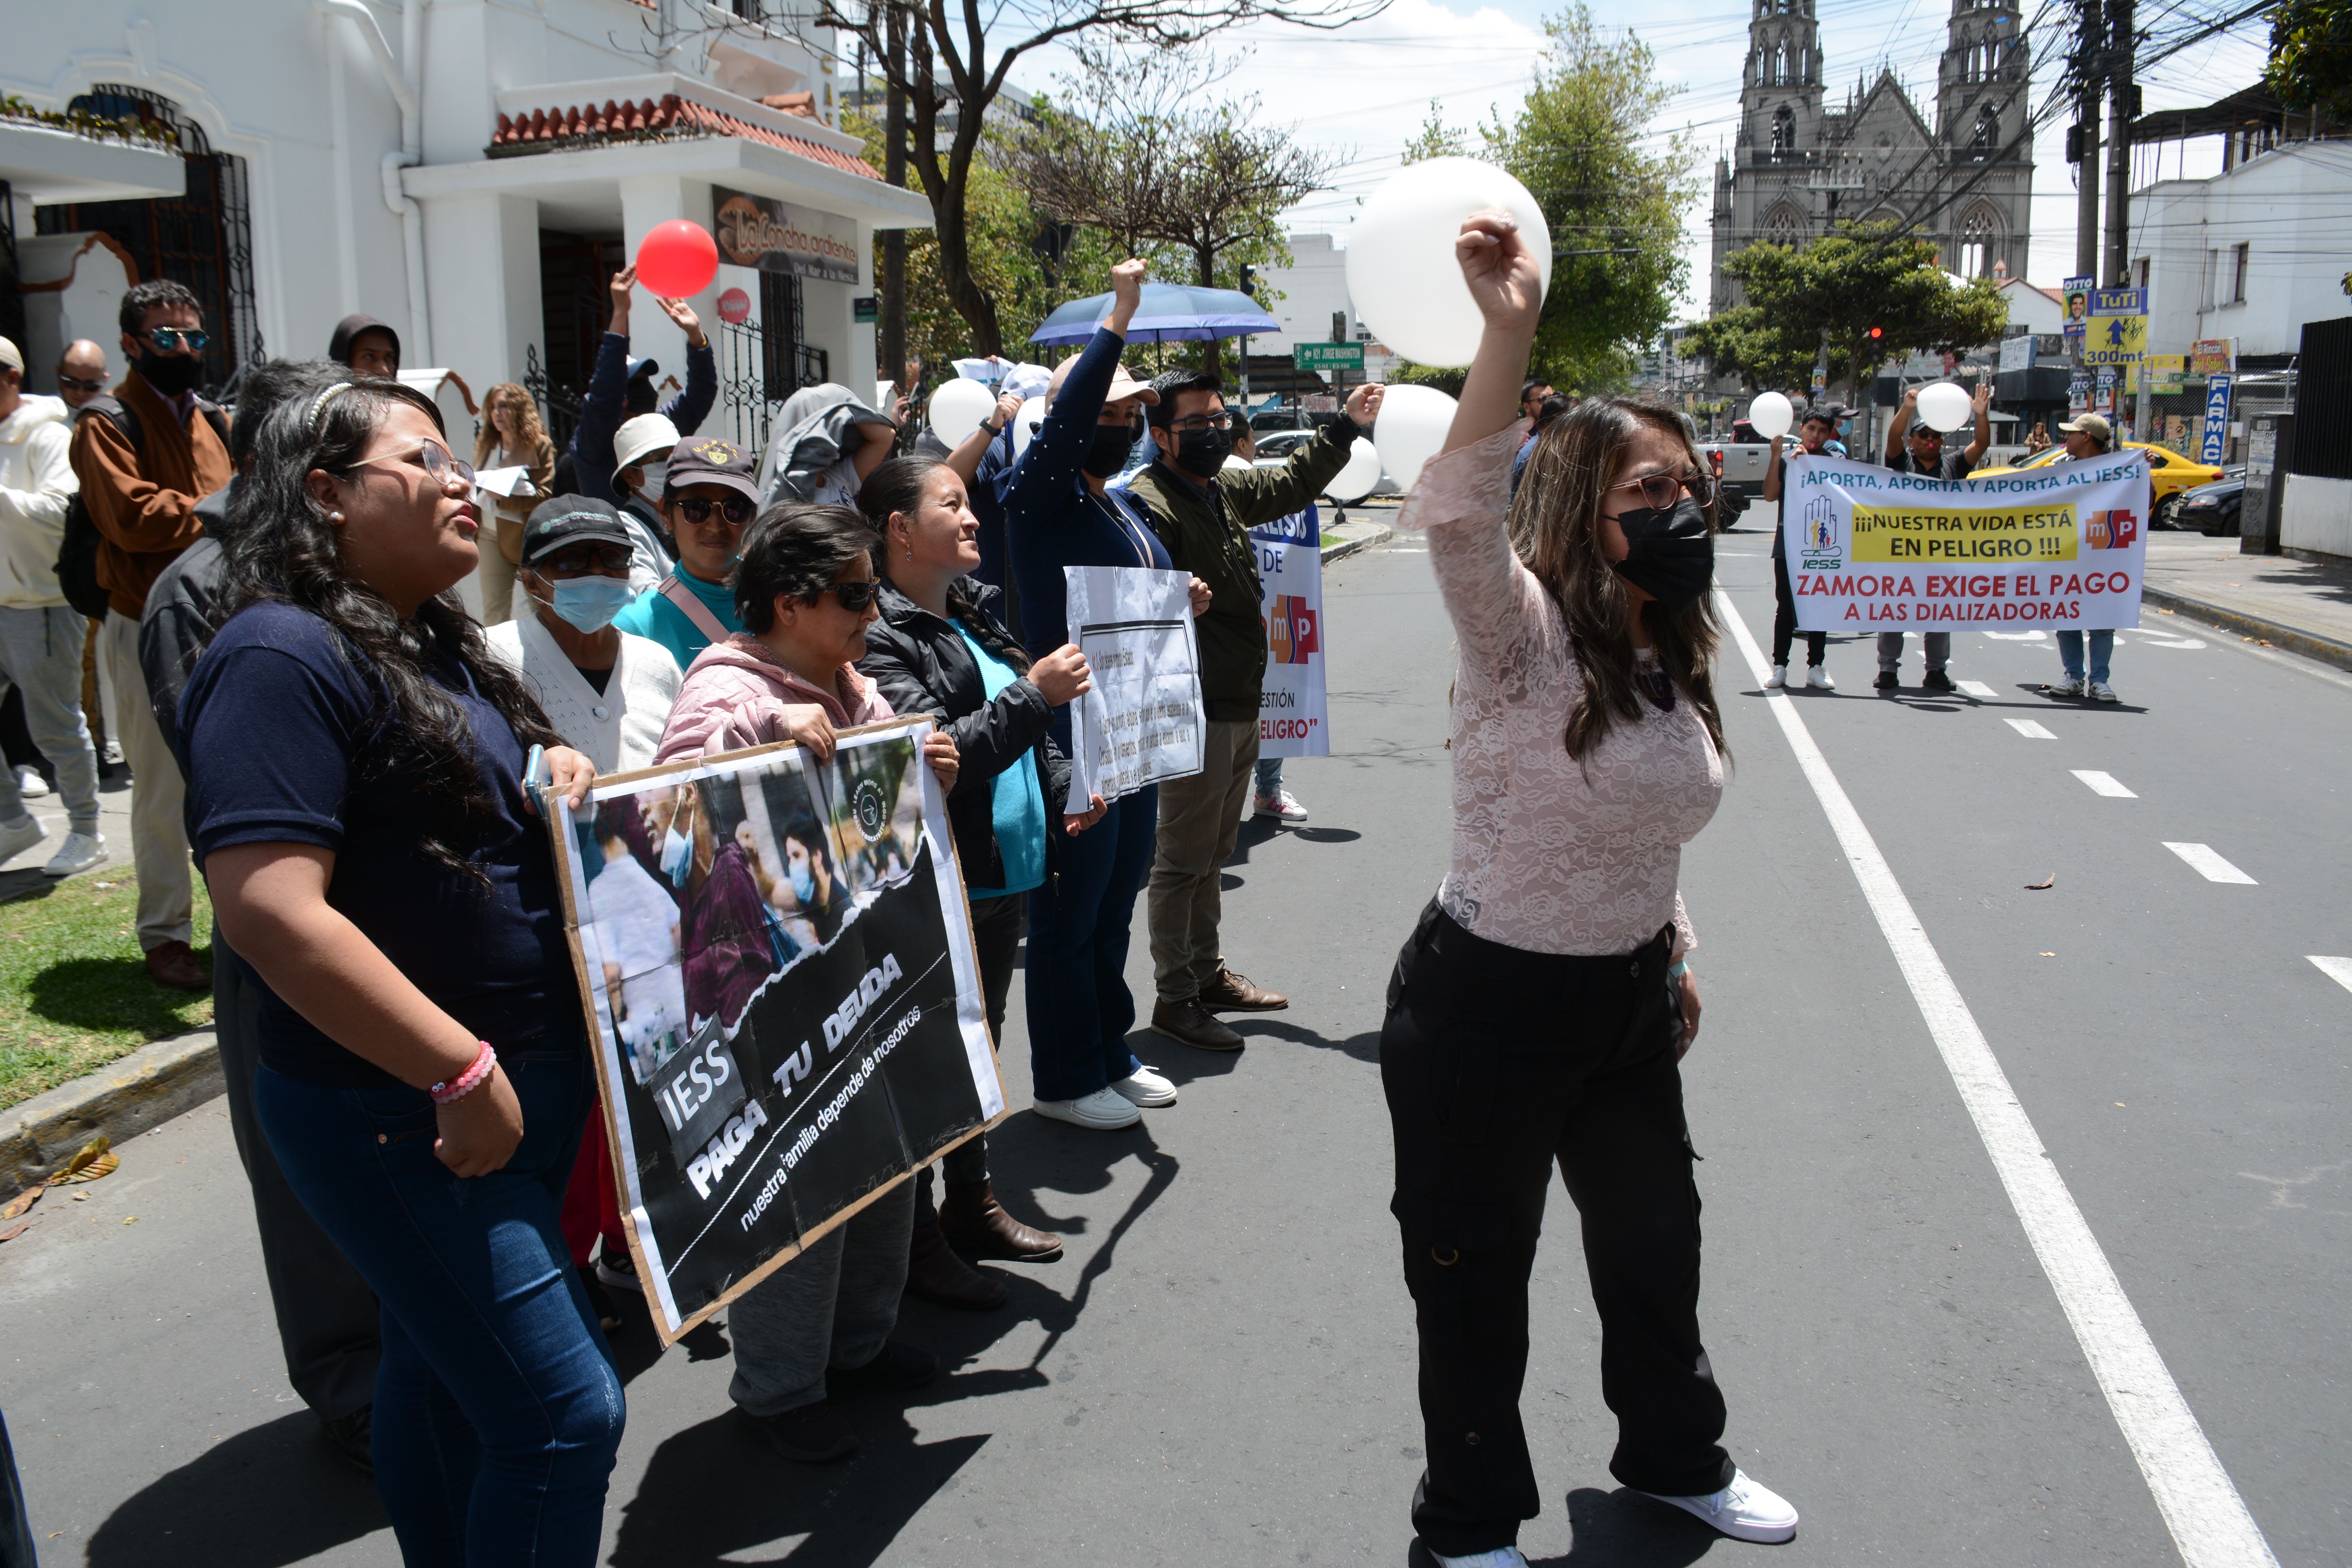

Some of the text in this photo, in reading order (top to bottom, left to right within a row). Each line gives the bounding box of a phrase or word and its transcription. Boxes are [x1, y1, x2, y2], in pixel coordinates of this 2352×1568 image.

[2064, 278, 2093, 290] OTTO
[1322, 348, 1334, 359] JORGE
[1335, 347, 1360, 359] WASHINGTON
[2203, 379, 2228, 465] FARMAC
[1888, 477, 1962, 492] APORTA
[1967, 481, 1978, 492] Y
[1984, 476, 2061, 492] APORTA
[2067, 473, 2091, 485] AL
[2096, 465, 2140, 483] IESS!
[1968, 515, 2016, 531] VIDA
[2023, 510, 2072, 529] ESTÁ
[1891, 538, 1921, 556] EN
[1929, 538, 2032, 557] PELIGRO
[1263, 548, 1283, 573] DE
[1797, 572, 2129, 598] ZAMORA EXIGE EL PAGO
[1844, 601, 2080, 621] A LAS DIALIZADORAS
[1260, 688, 1294, 708] ESTIÓN
[663, 1040, 729, 1131] IESS
[686, 953, 902, 1200] PAGA TU DEUDA
[741, 1005, 920, 1231] nuestra familia depende de nosotros
